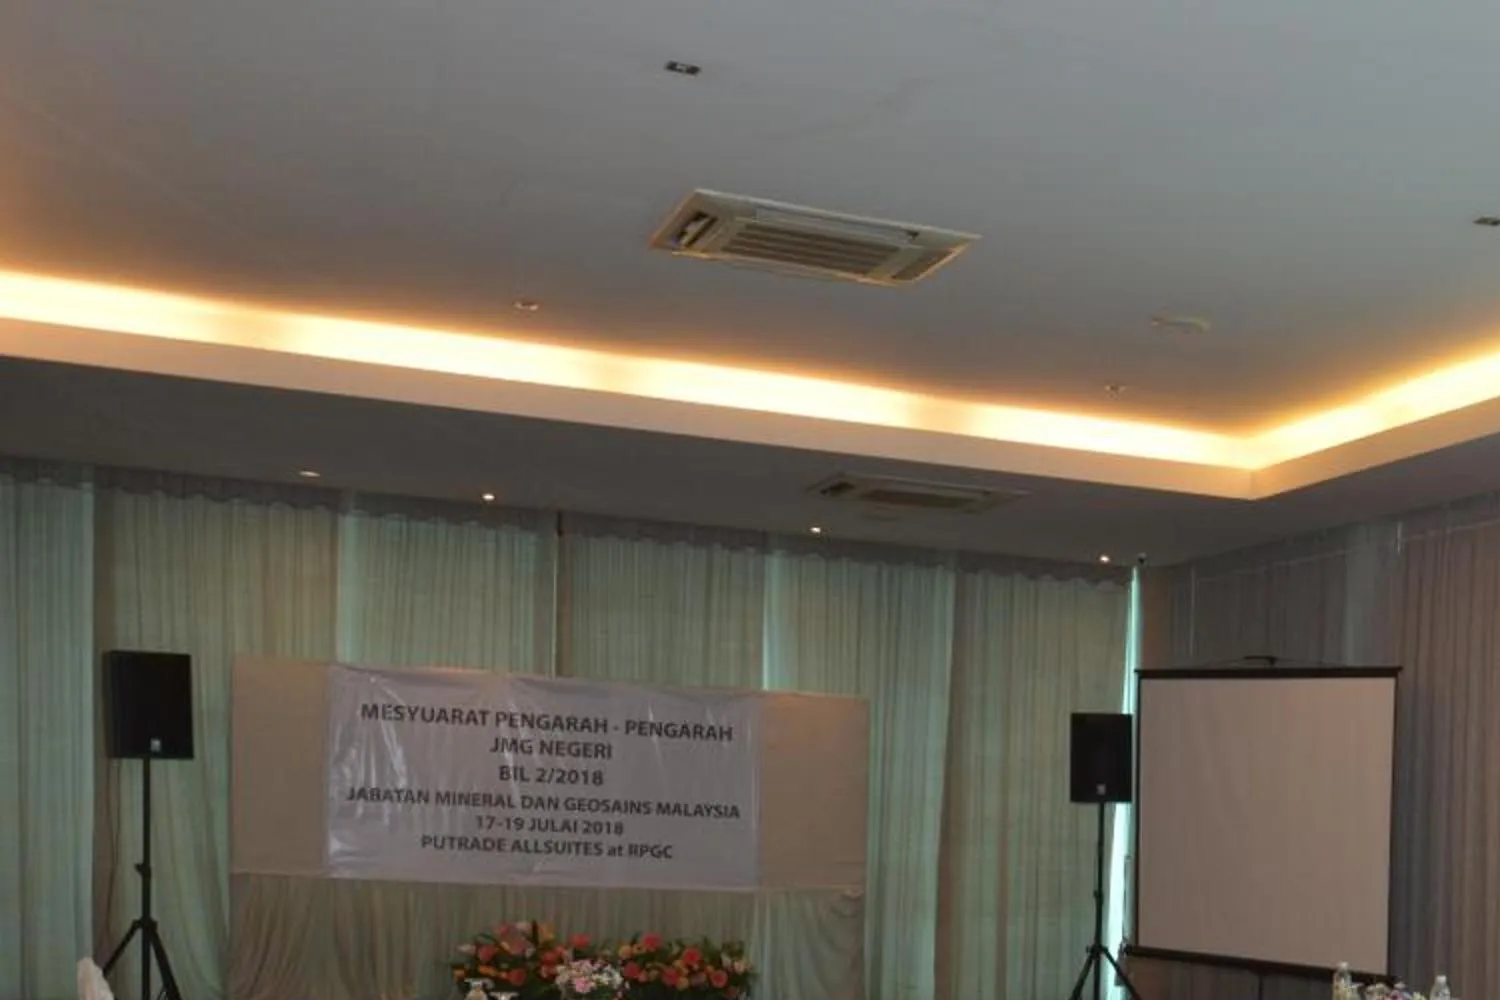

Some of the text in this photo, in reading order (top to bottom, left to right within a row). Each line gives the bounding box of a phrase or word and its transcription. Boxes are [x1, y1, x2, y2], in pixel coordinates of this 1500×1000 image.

[361, 703, 490, 726] MESYUARAT
[494, 711, 608, 734] PENGARAH
[625, 719, 733, 742] PENGARAH
[489, 736, 612, 760] JMG NEGERI
[499, 765, 604, 786] BIL 2/2018
[347, 786, 741, 819] JABATAN MINERAL DAN GEOSAINS MALAYSIA
[476, 815, 624, 835] 17-19 JULAI 2018
[421, 835, 673, 859] PUTRADE ALLSUITES at RPGC
